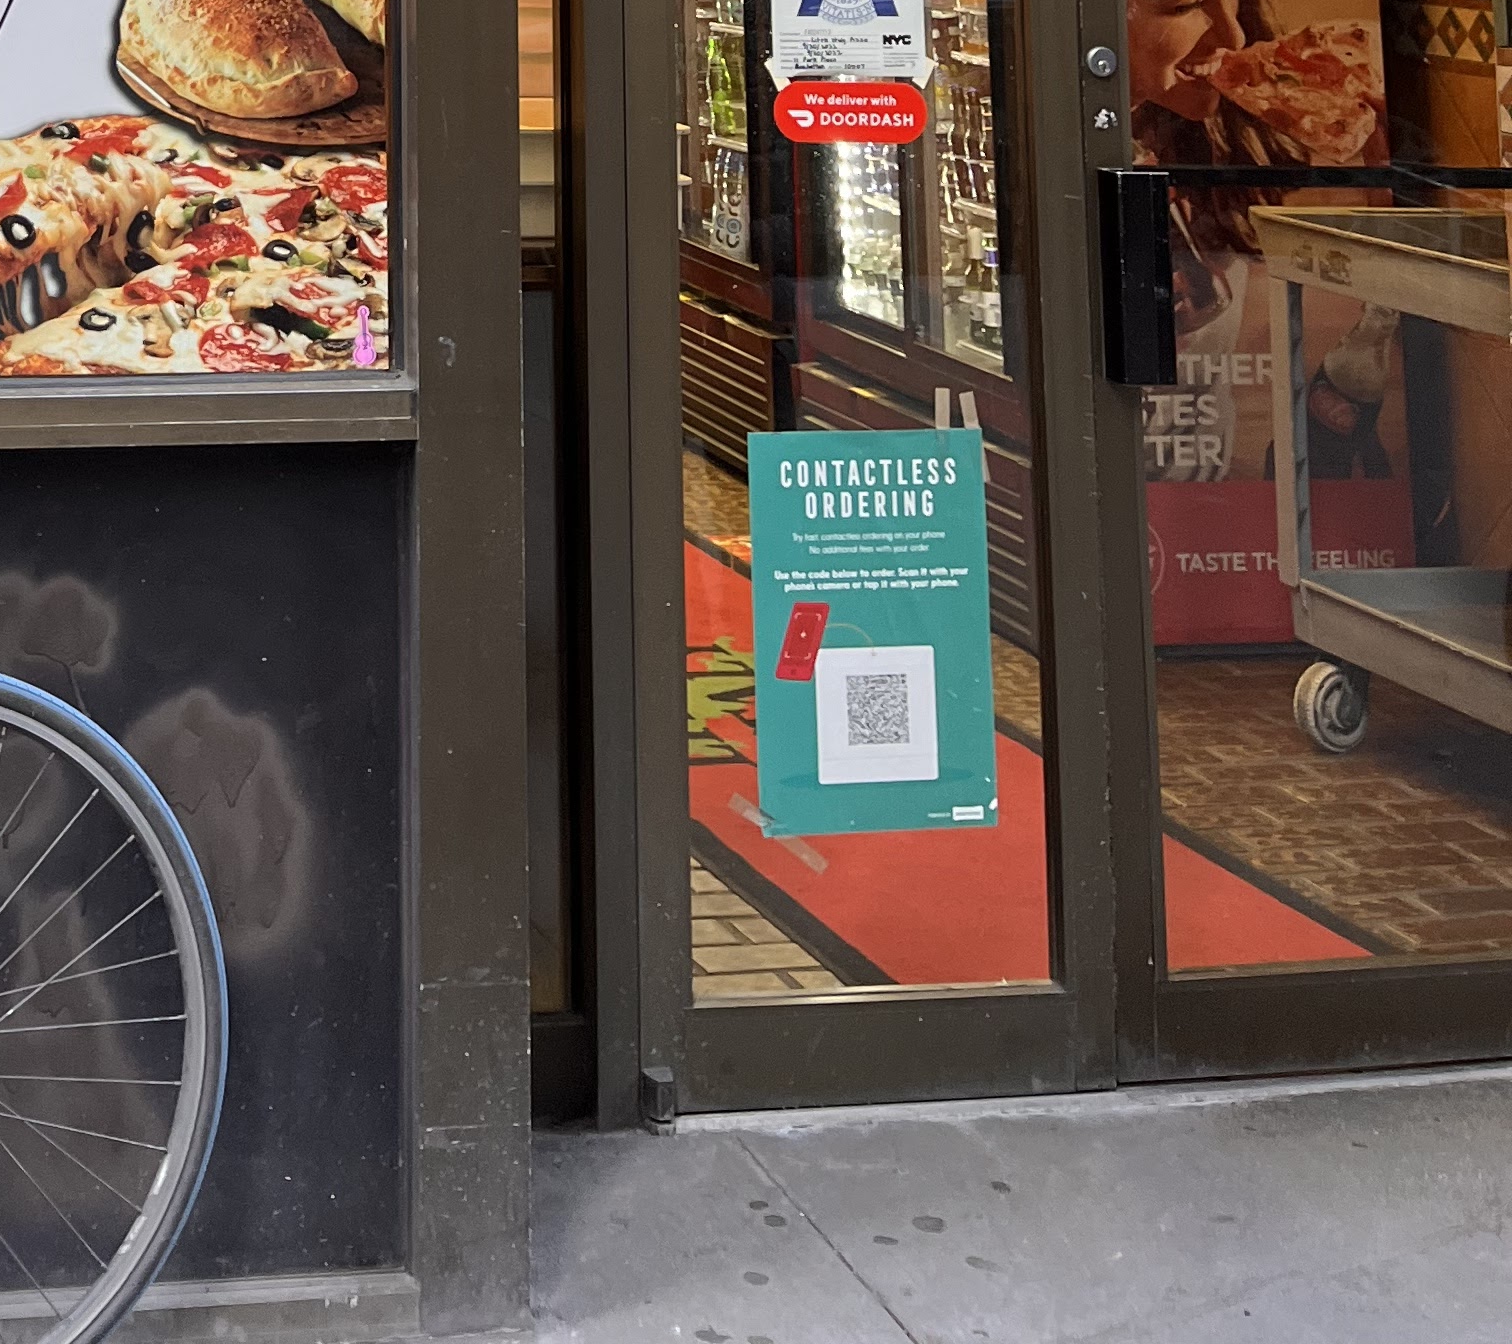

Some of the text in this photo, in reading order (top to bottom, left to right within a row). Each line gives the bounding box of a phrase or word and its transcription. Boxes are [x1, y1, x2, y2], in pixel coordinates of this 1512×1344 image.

[883, 35, 911, 45] NYC
[804, 93, 897, 106] We deliver with
[820, 112, 914, 127] DOORDASH
[780, 457, 956, 488] CONTACTLESS
[805, 490, 934, 519] ORDERING
[1176, 552, 1248, 573] TASTE
[1312, 549, 1395, 570] EELING
[774, 570, 789, 580] Use
[791, 570, 806, 579] the
[808, 569, 830, 579] code
[832, 569, 858, 578] below
[898, 567, 919, 577] Scan
[929, 567, 948, 576] with
[949, 567, 969, 577] your
[817, 582, 850, 590] camera
[890, 579, 909, 588] with
[911, 580, 929, 589] your
